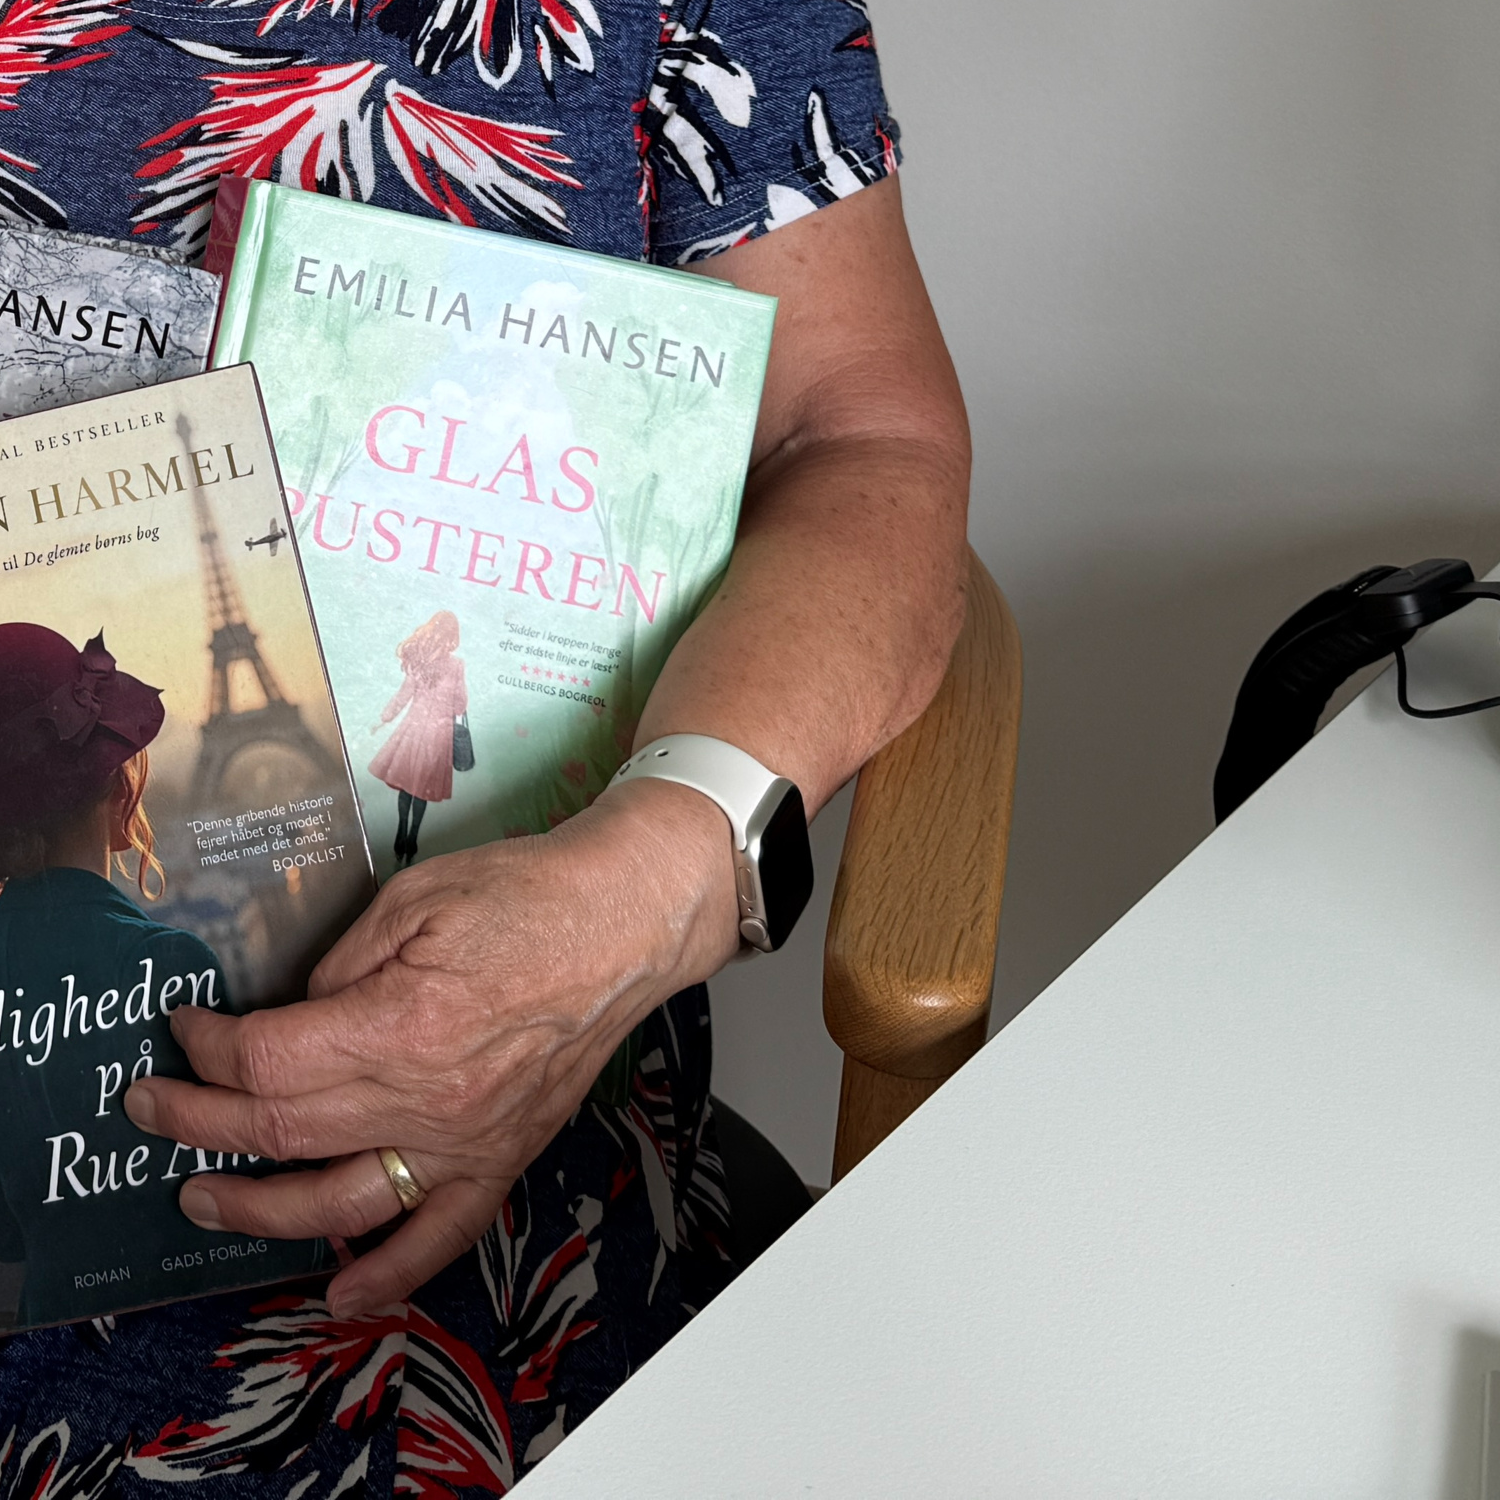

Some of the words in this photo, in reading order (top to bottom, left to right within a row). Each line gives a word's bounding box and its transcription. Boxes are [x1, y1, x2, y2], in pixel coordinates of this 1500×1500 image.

[293, 255, 473, 332] EMILIA
[498, 302, 726, 389] HANSEN
[34, 411, 166, 453] BESTSELLER
[365, 404, 599, 513] GLAS
[27, 441, 255, 525] HARMEL
[3, 554, 19, 572] til
[23, 551, 43, 569] De
[46, 542, 91, 566] glemte
[136, 525, 160, 542] bog
[498, 639, 524, 652] efter
[525, 645, 555, 660] sidste
[556, 652, 577, 666] linje
[578, 658, 589, 667] er
[547, 632, 589, 649] kroppen
[590, 642, 622, 660] længe
[497, 674, 556, 696] GULLBERGS
[558, 688, 607, 708] BOGREOL
[187, 817, 233, 834] "Denne
[235, 804, 286, 828] gribende
[288, 795, 334, 813] historie
[196, 835, 228, 852] fejrer
[231, 826, 265, 843] håbet
[268, 824, 284, 836] og
[286, 814, 325, 832] modet
[327, 811, 332, 823] i
[201, 850, 240, 867] mødet
[243, 841, 269, 857] med
[272, 837, 292, 851] det
[295, 827, 331, 846] onde."
[272, 845, 345, 872] BOOKLIST
[42, 1131, 150, 1204] Rue
[74, 1266, 131, 1289] ROMAN
[161, 1251, 203, 1272] GADS
[208, 1239, 267, 1263] FORLAG
